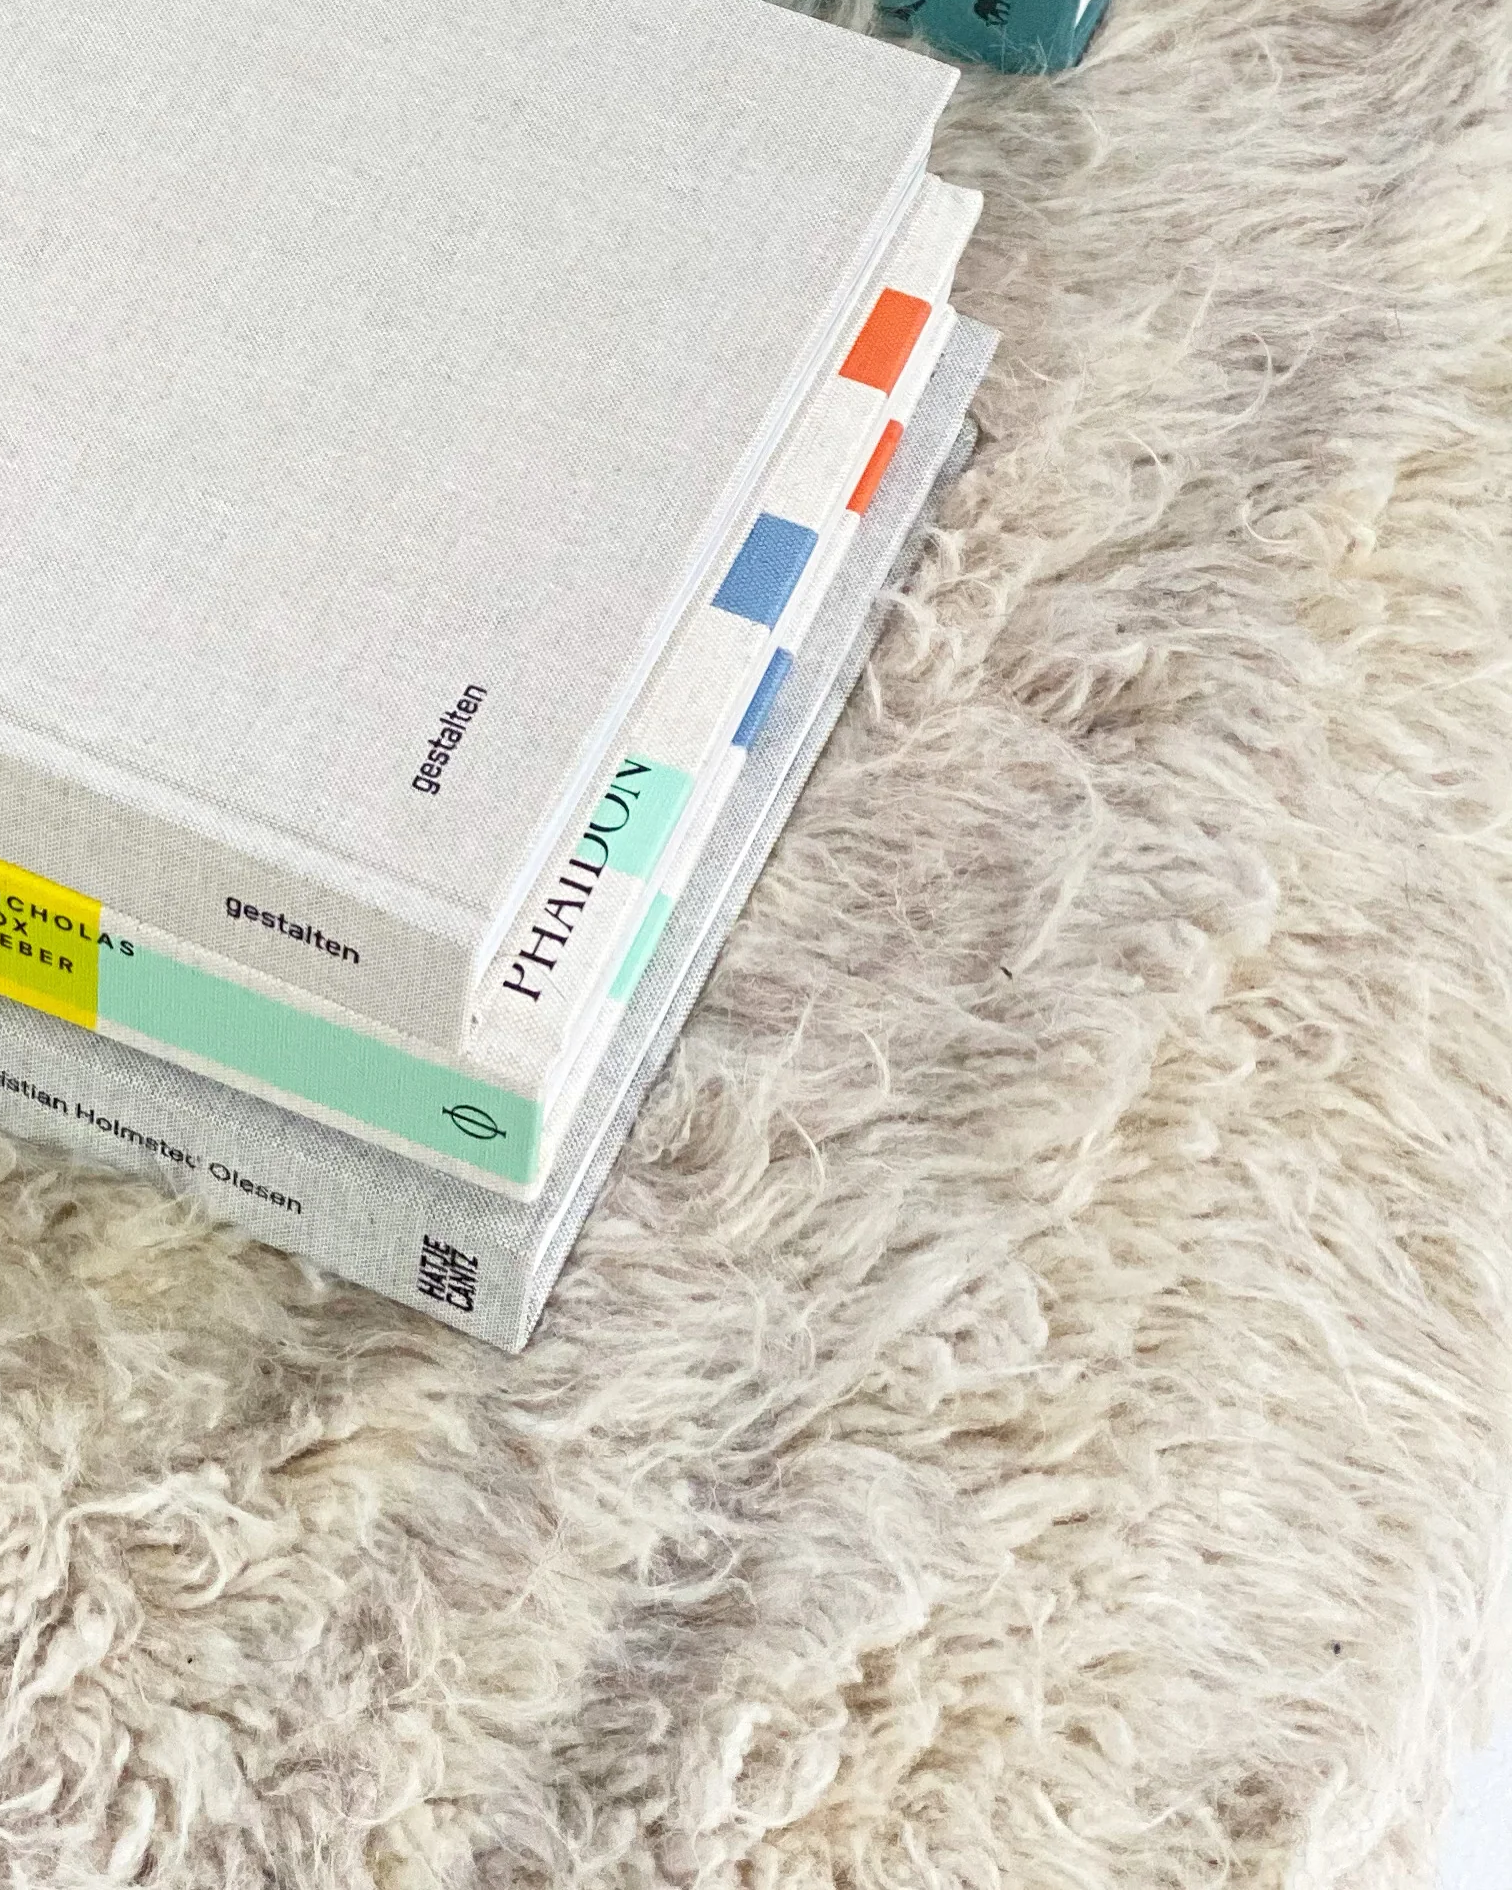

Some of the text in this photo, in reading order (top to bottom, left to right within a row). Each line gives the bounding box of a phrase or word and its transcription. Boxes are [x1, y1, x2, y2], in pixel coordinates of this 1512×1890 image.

[411, 681, 488, 797] gestalten
[502, 756, 654, 1004] PHAIDON
[224, 894, 361, 966] gestalten
[209, 1161, 303, 1215] Olesen
[417, 1233, 451, 1302] HATJE
[445, 1247, 479, 1312] CANTZ
